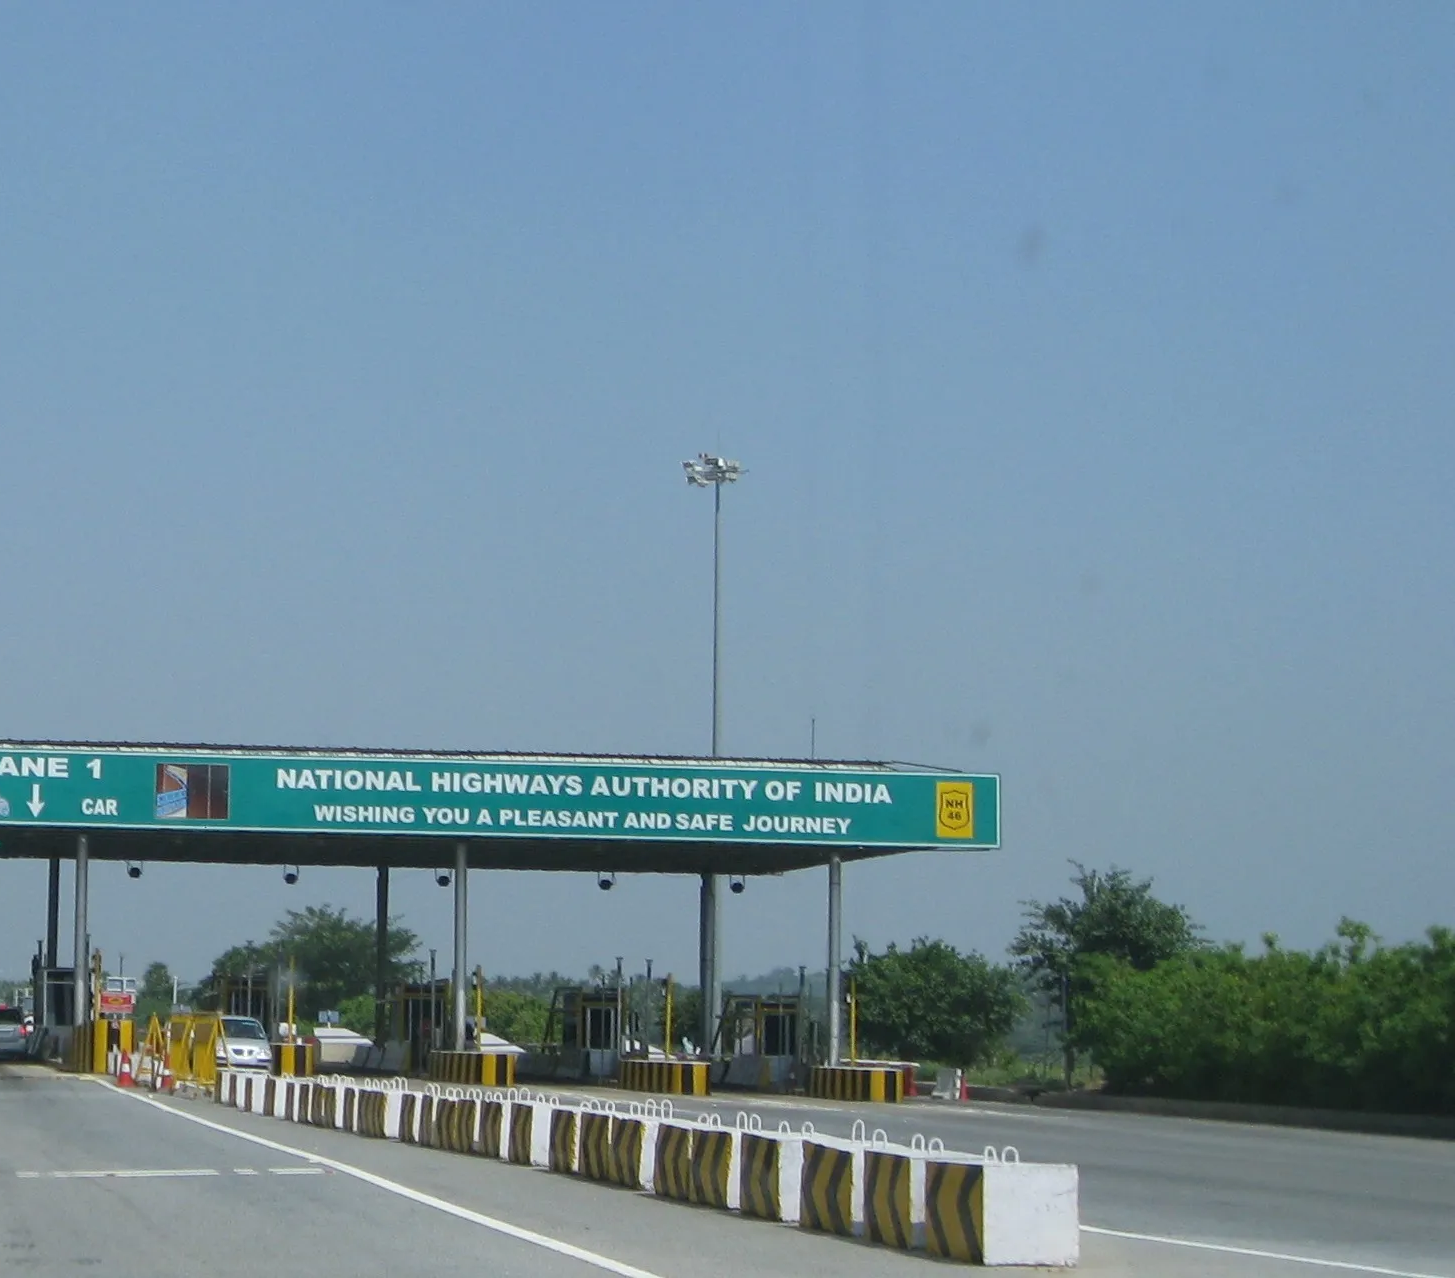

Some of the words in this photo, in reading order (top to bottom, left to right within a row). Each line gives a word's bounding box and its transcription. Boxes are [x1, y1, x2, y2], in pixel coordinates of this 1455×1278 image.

[87, 759, 101, 778] 1
[277, 769, 421, 791] NATIONAL
[432, 772, 582, 795] HIGHWAYS
[591, 776, 757, 799] AUTHORITY
[765, 781, 801, 800] OF
[816, 782, 892, 803] INDIA
[82, 799, 117, 815] CAR
[946, 800, 963, 809] NH
[315, 805, 414, 823] WISHING
[423, 808, 469, 824] YOU
[477, 809, 492, 825] A
[500, 810, 618, 827] PLEASANT
[624, 813, 671, 828] AND
[676, 814, 732, 830] SAFE
[743, 816, 850, 834] JOURNEY
